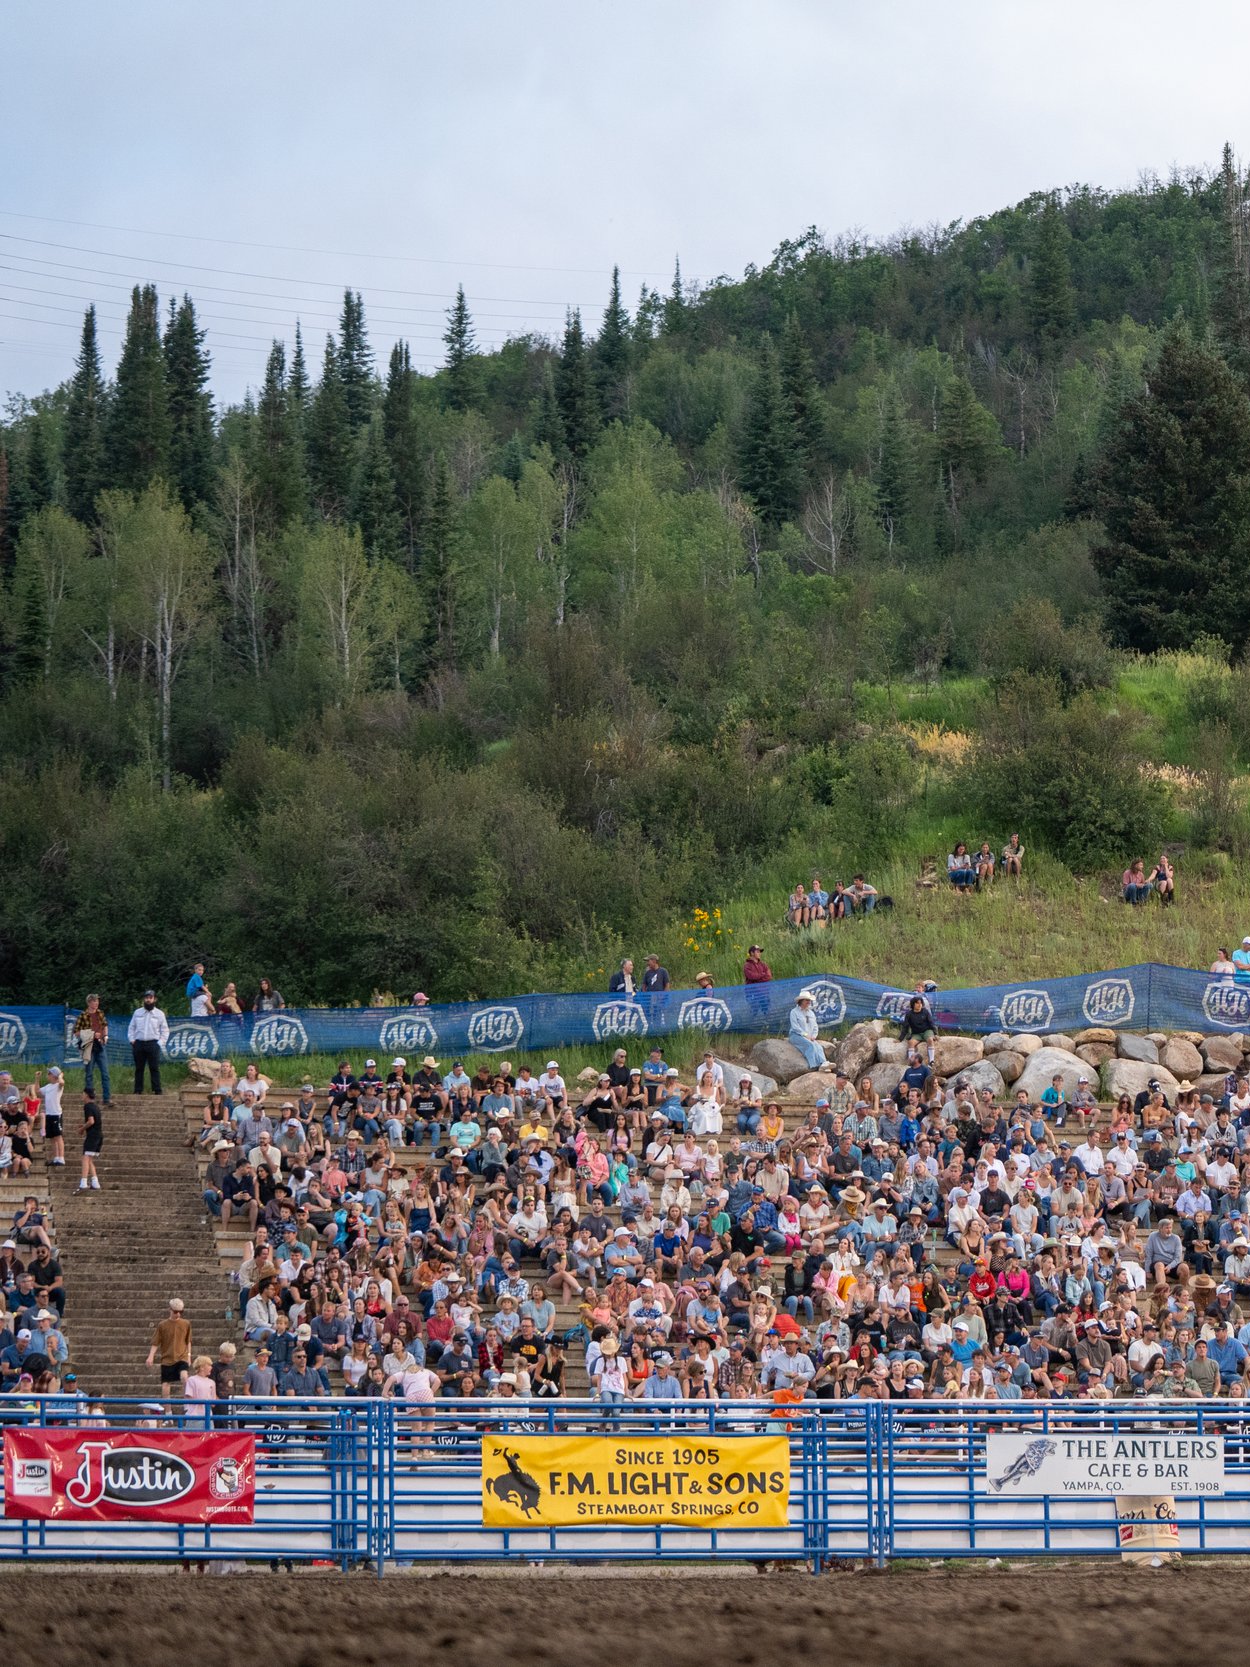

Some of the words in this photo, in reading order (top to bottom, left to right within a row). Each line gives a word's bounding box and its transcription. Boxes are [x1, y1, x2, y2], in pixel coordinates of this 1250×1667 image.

[615, 1449, 664, 1465] SINCE
[672, 1448, 720, 1465] 1905
[1062, 1440, 1107, 1458] THE
[1114, 1440, 1217, 1459] ANTLERS
[66, 1441, 184, 1508] Justin
[1088, 1463, 1131, 1478] CAFE
[1137, 1463, 1149, 1478] &
[1155, 1463, 1189, 1478] BAR
[549, 1471, 601, 1495] F.M.
[608, 1471, 688, 1495] LIGHT
[690, 1480, 703, 1494] &
[707, 1471, 784, 1494] SONS
[1063, 1481, 1104, 1492] YAMPA,
[1106, 1481, 1124, 1491] CO.
[1171, 1482, 1192, 1491] EST.
[1195, 1482, 1220, 1491] 1908
[577, 1502, 664, 1515] STEAMBOAT
[671, 1502, 735, 1515] SPRINGS,
[738, 1501, 759, 1515] CO
